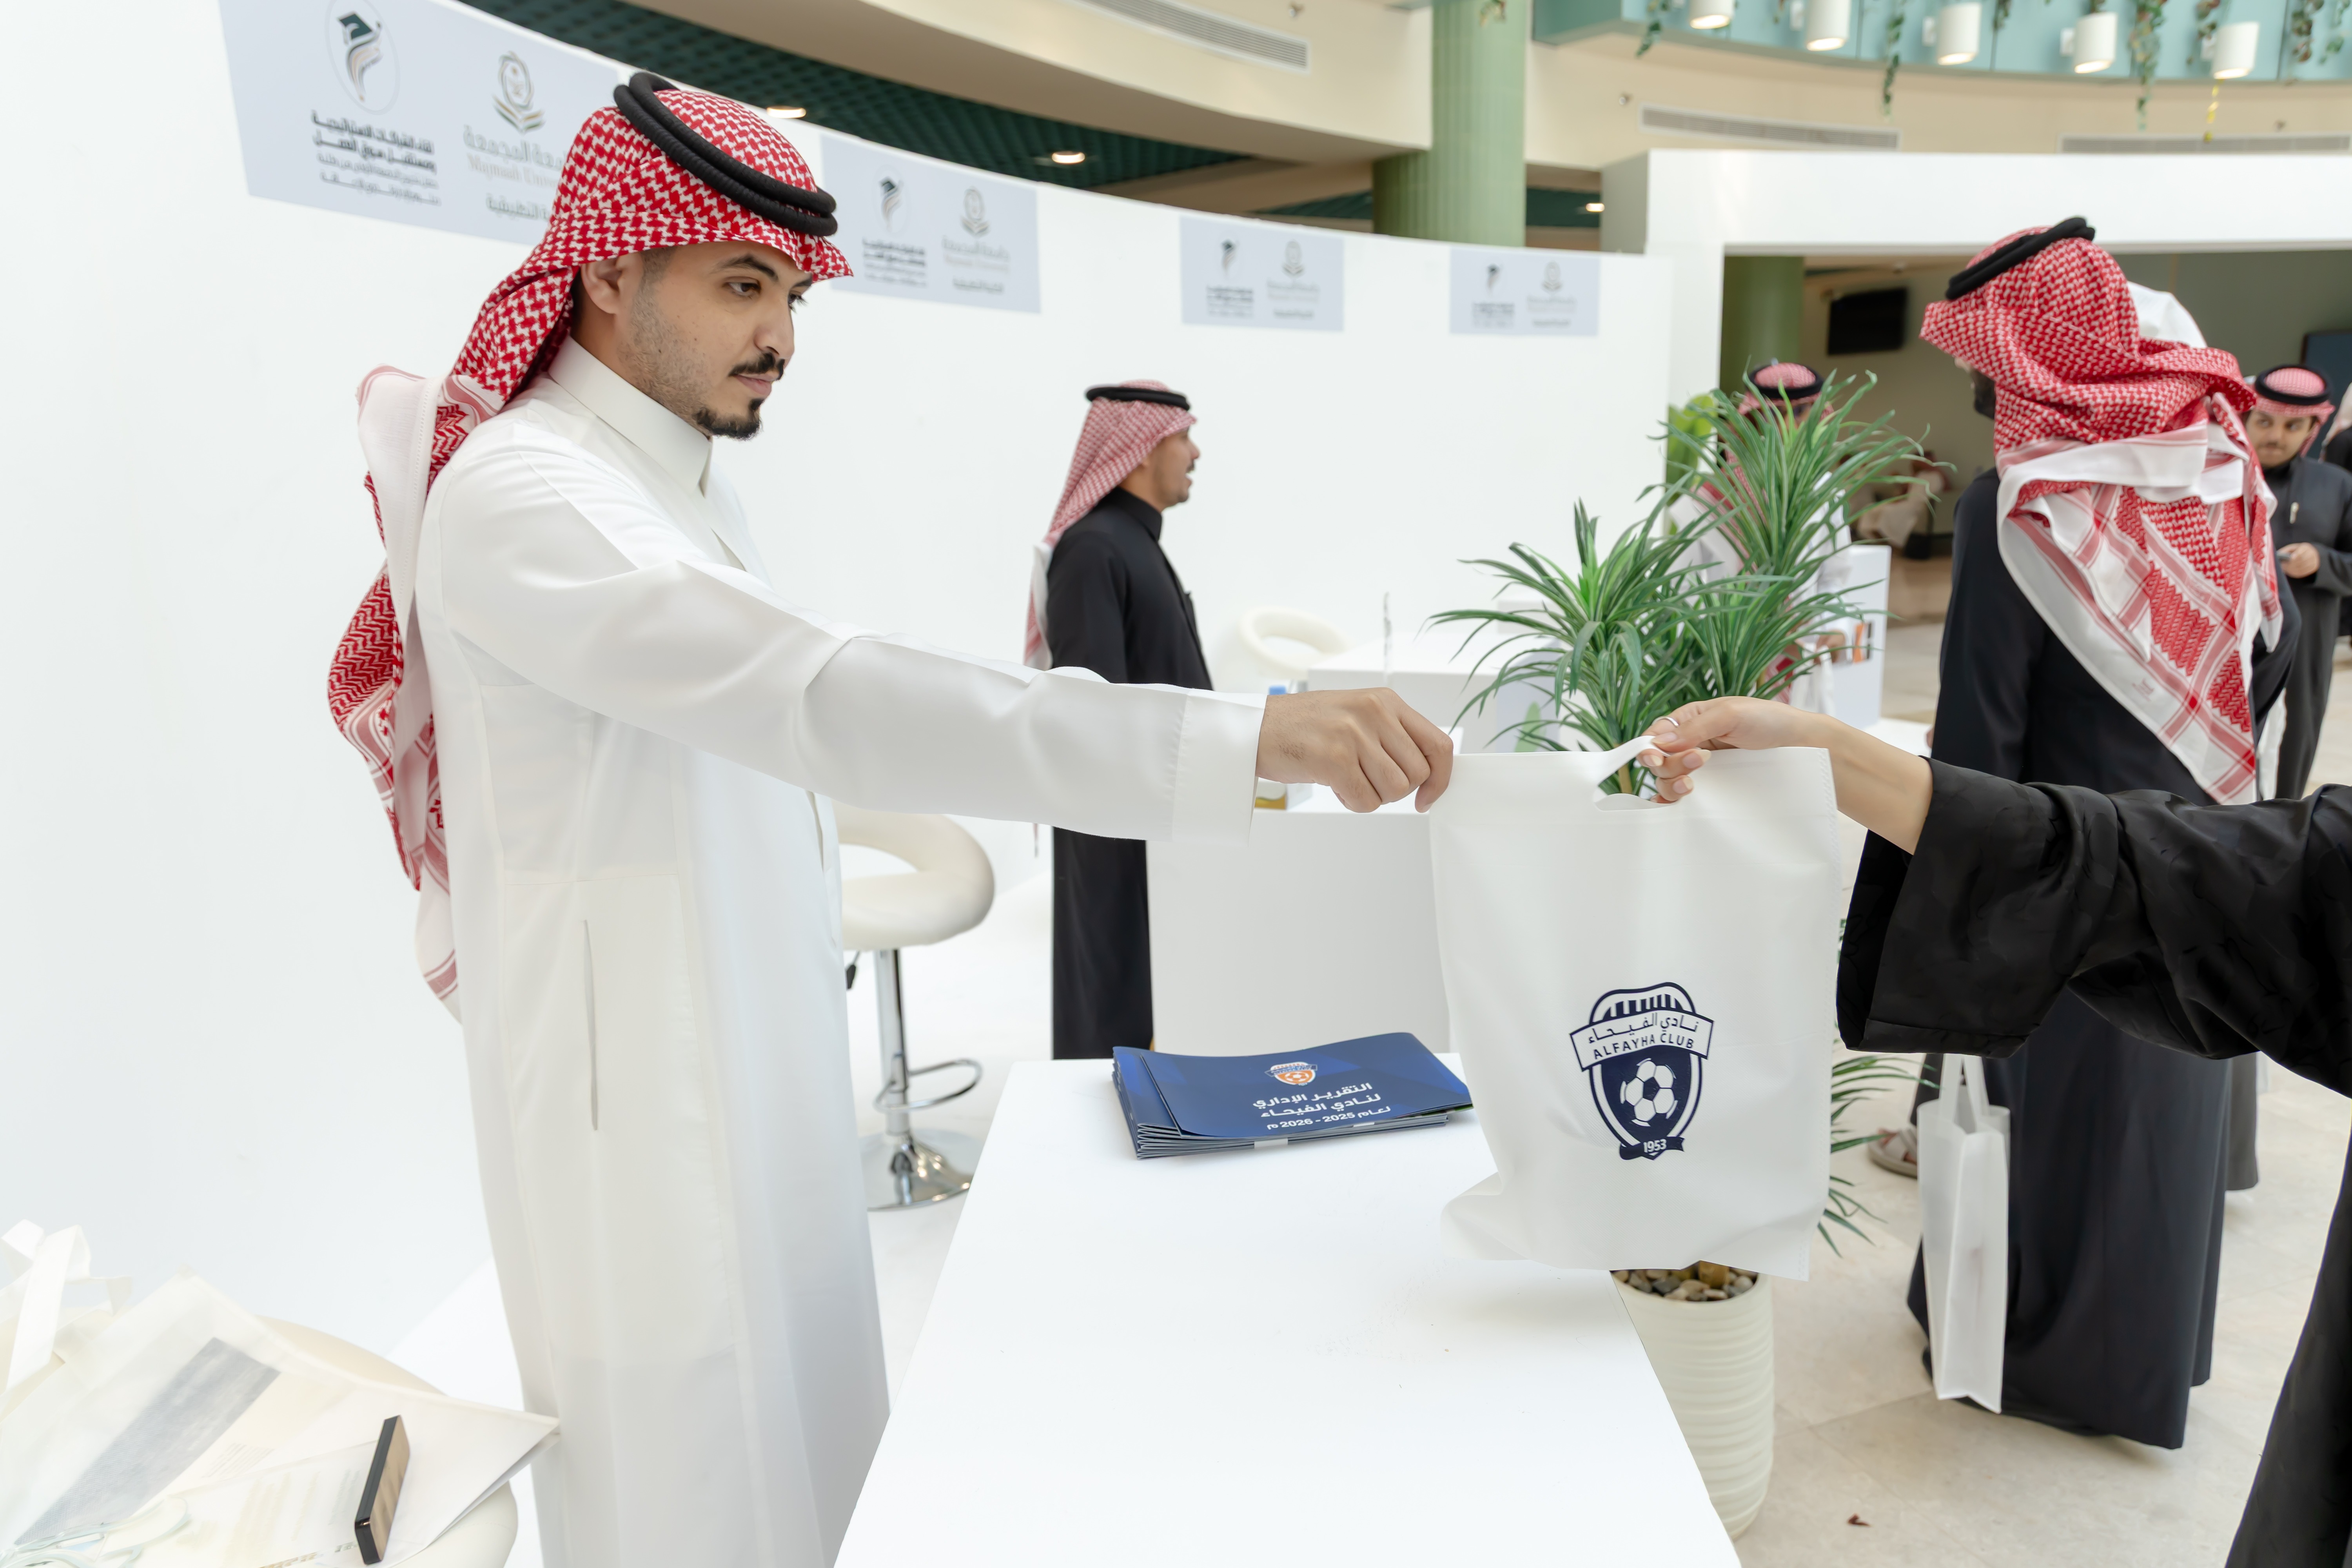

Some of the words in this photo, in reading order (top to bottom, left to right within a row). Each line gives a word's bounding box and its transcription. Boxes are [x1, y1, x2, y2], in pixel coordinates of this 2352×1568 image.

[1589, 1013, 1657, 1044] الفيحاء
[1660, 1014, 1699, 1033] نادي
[1593, 1034, 1655, 1059] ALFAYHA
[1660, 1033, 1694, 1049] CLUB
[1311, 1083, 1373, 1101] التقرير
[1253, 1094, 1308, 1109] الإداري
[1331, 1093, 1381, 1112] لنادي
[1261, 1103, 1327, 1118] الفيحاء
[1322, 1112, 1356, 1122] 2025
[1357, 1106, 1391, 1118] لعام
[1280, 1118, 1313, 1127] 2026
[1643, 1139, 1667, 1153] 1953
